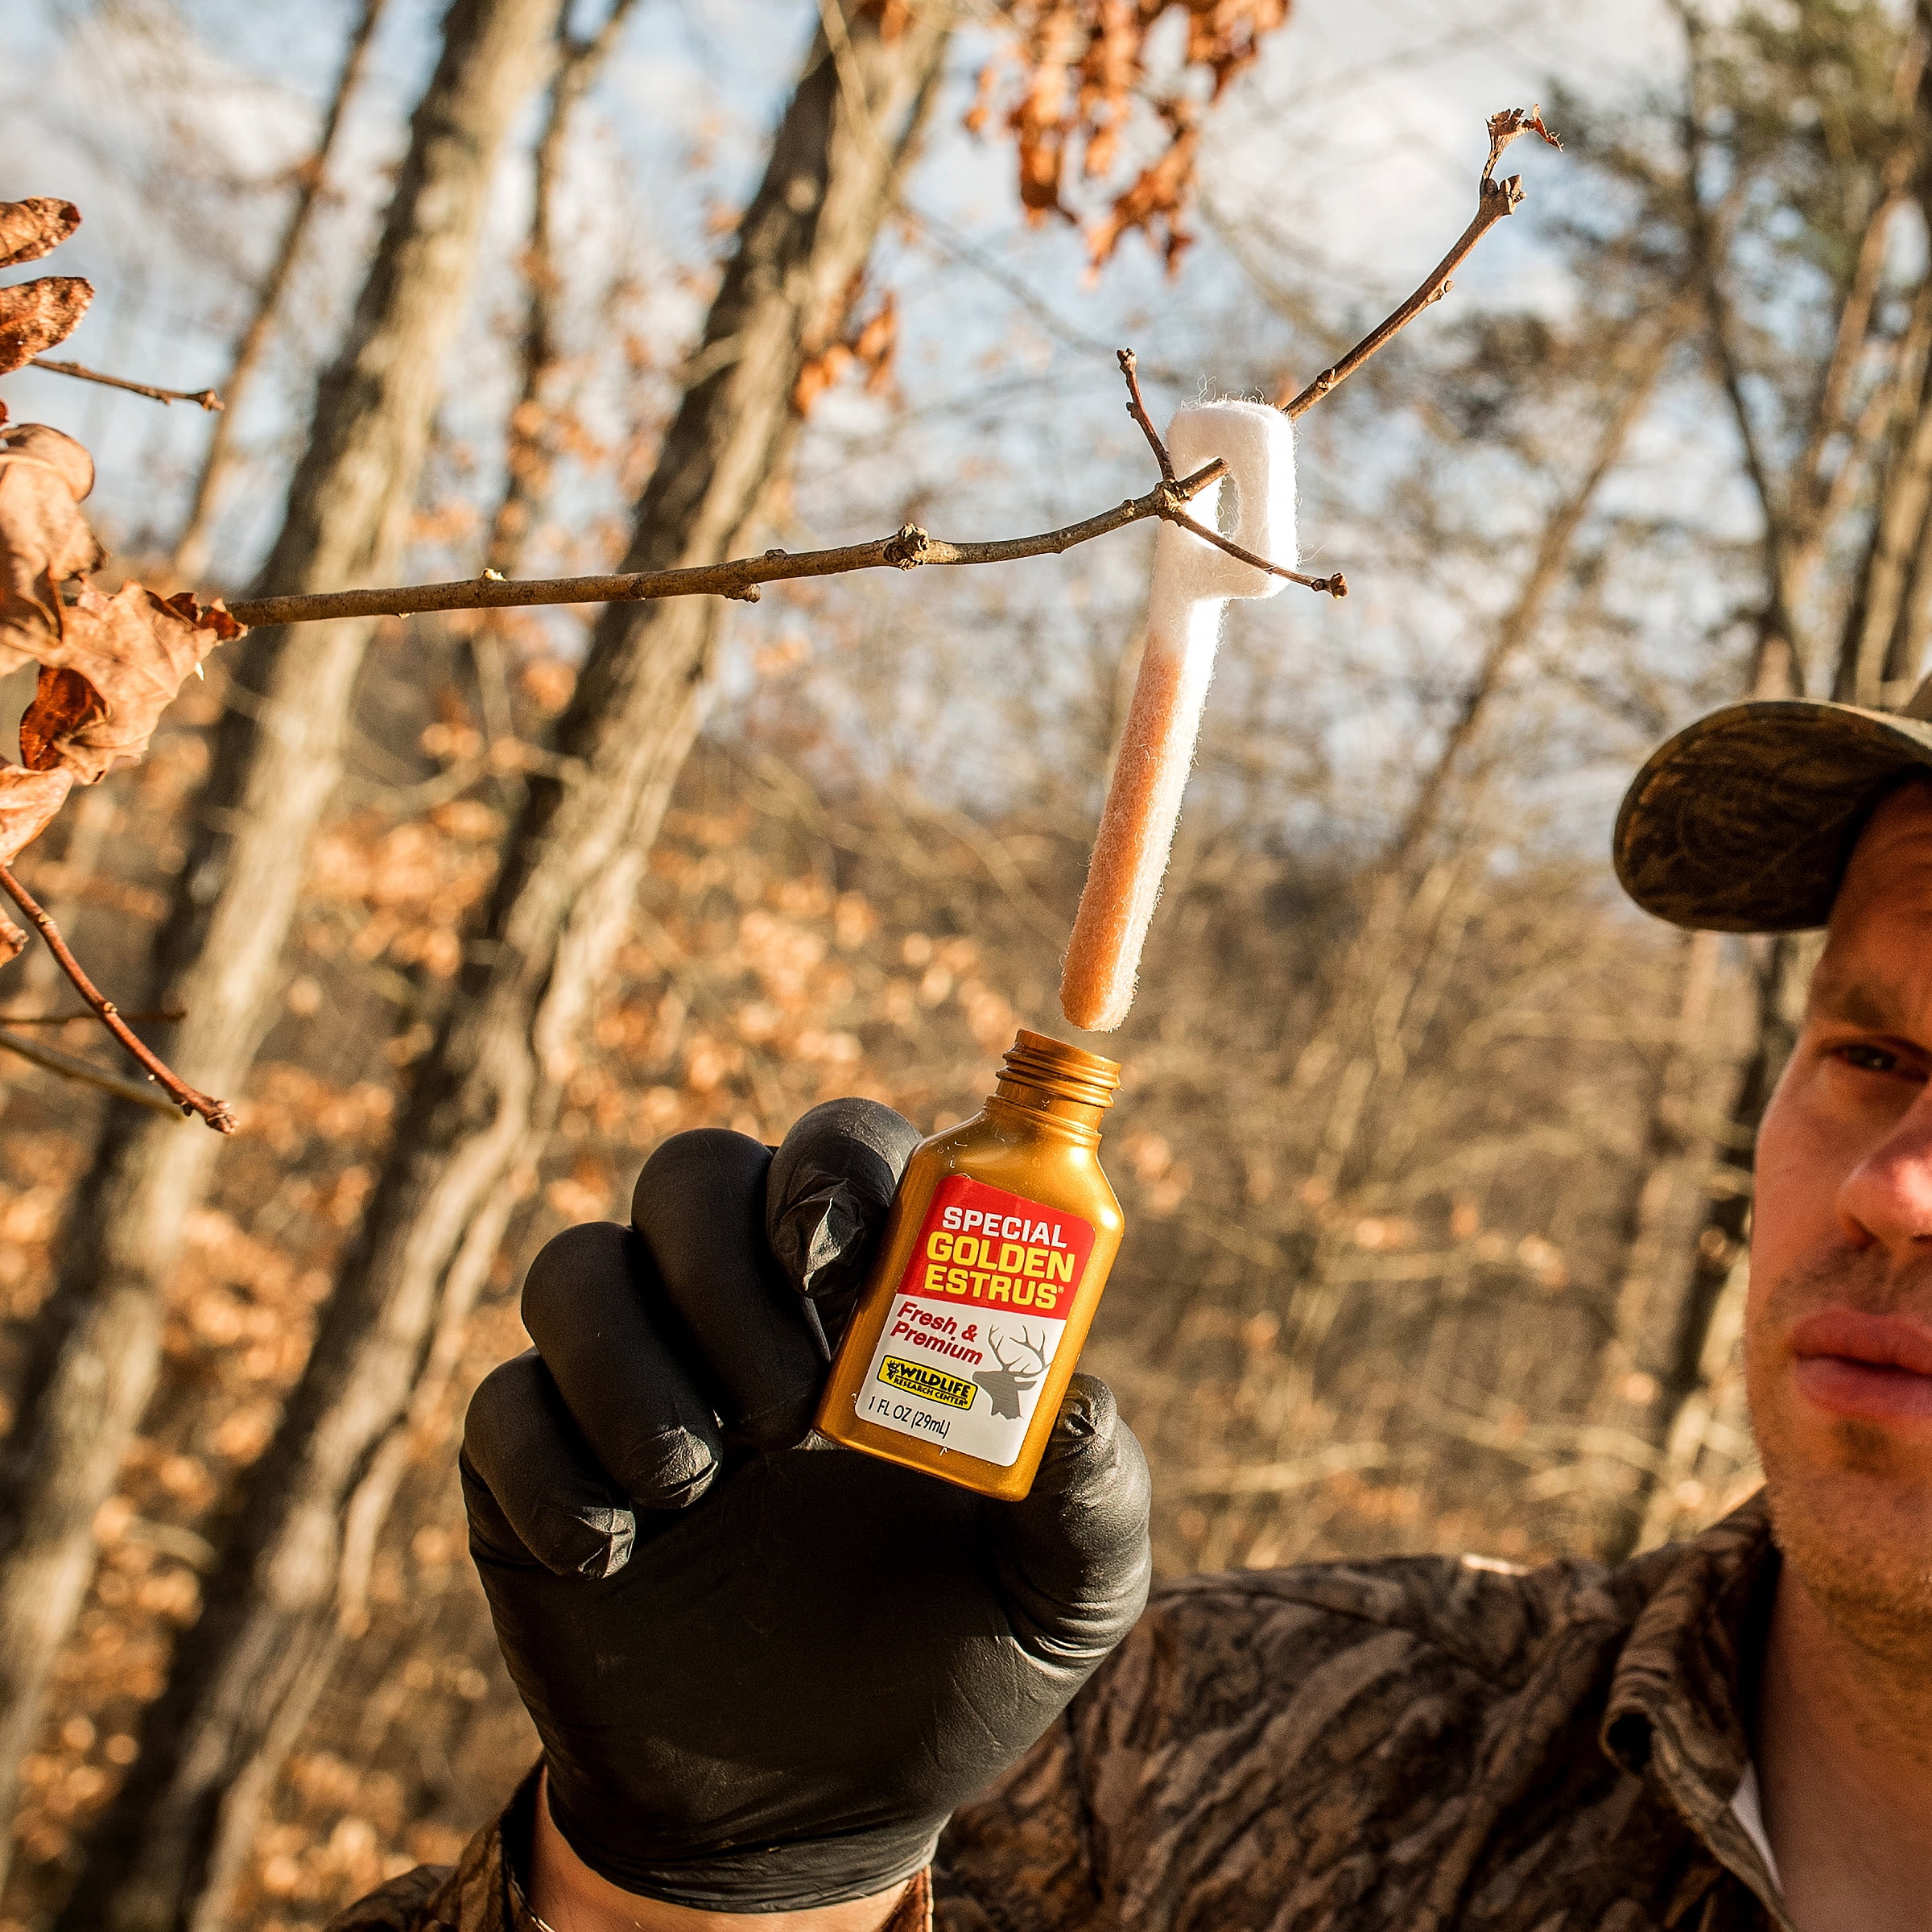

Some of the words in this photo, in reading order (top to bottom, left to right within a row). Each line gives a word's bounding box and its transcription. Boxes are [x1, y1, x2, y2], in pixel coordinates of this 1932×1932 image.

[942, 1206, 1067, 1248] SPECIAL
[927, 1231, 1075, 1282] GOLDEN
[890, 1320, 983, 1364] Premium
[897, 1301, 958, 1335] Fresh
[961, 1324, 978, 1342] &
[894, 1376, 934, 1396] RESEARCH
[900, 1364, 971, 1398] WILDLIFE
[868, 1396, 876, 1410] 1
[877, 1398, 890, 1416] FL
[893, 1405, 913, 1422] OZ
[910, 1410, 951, 1439] (29mL)
